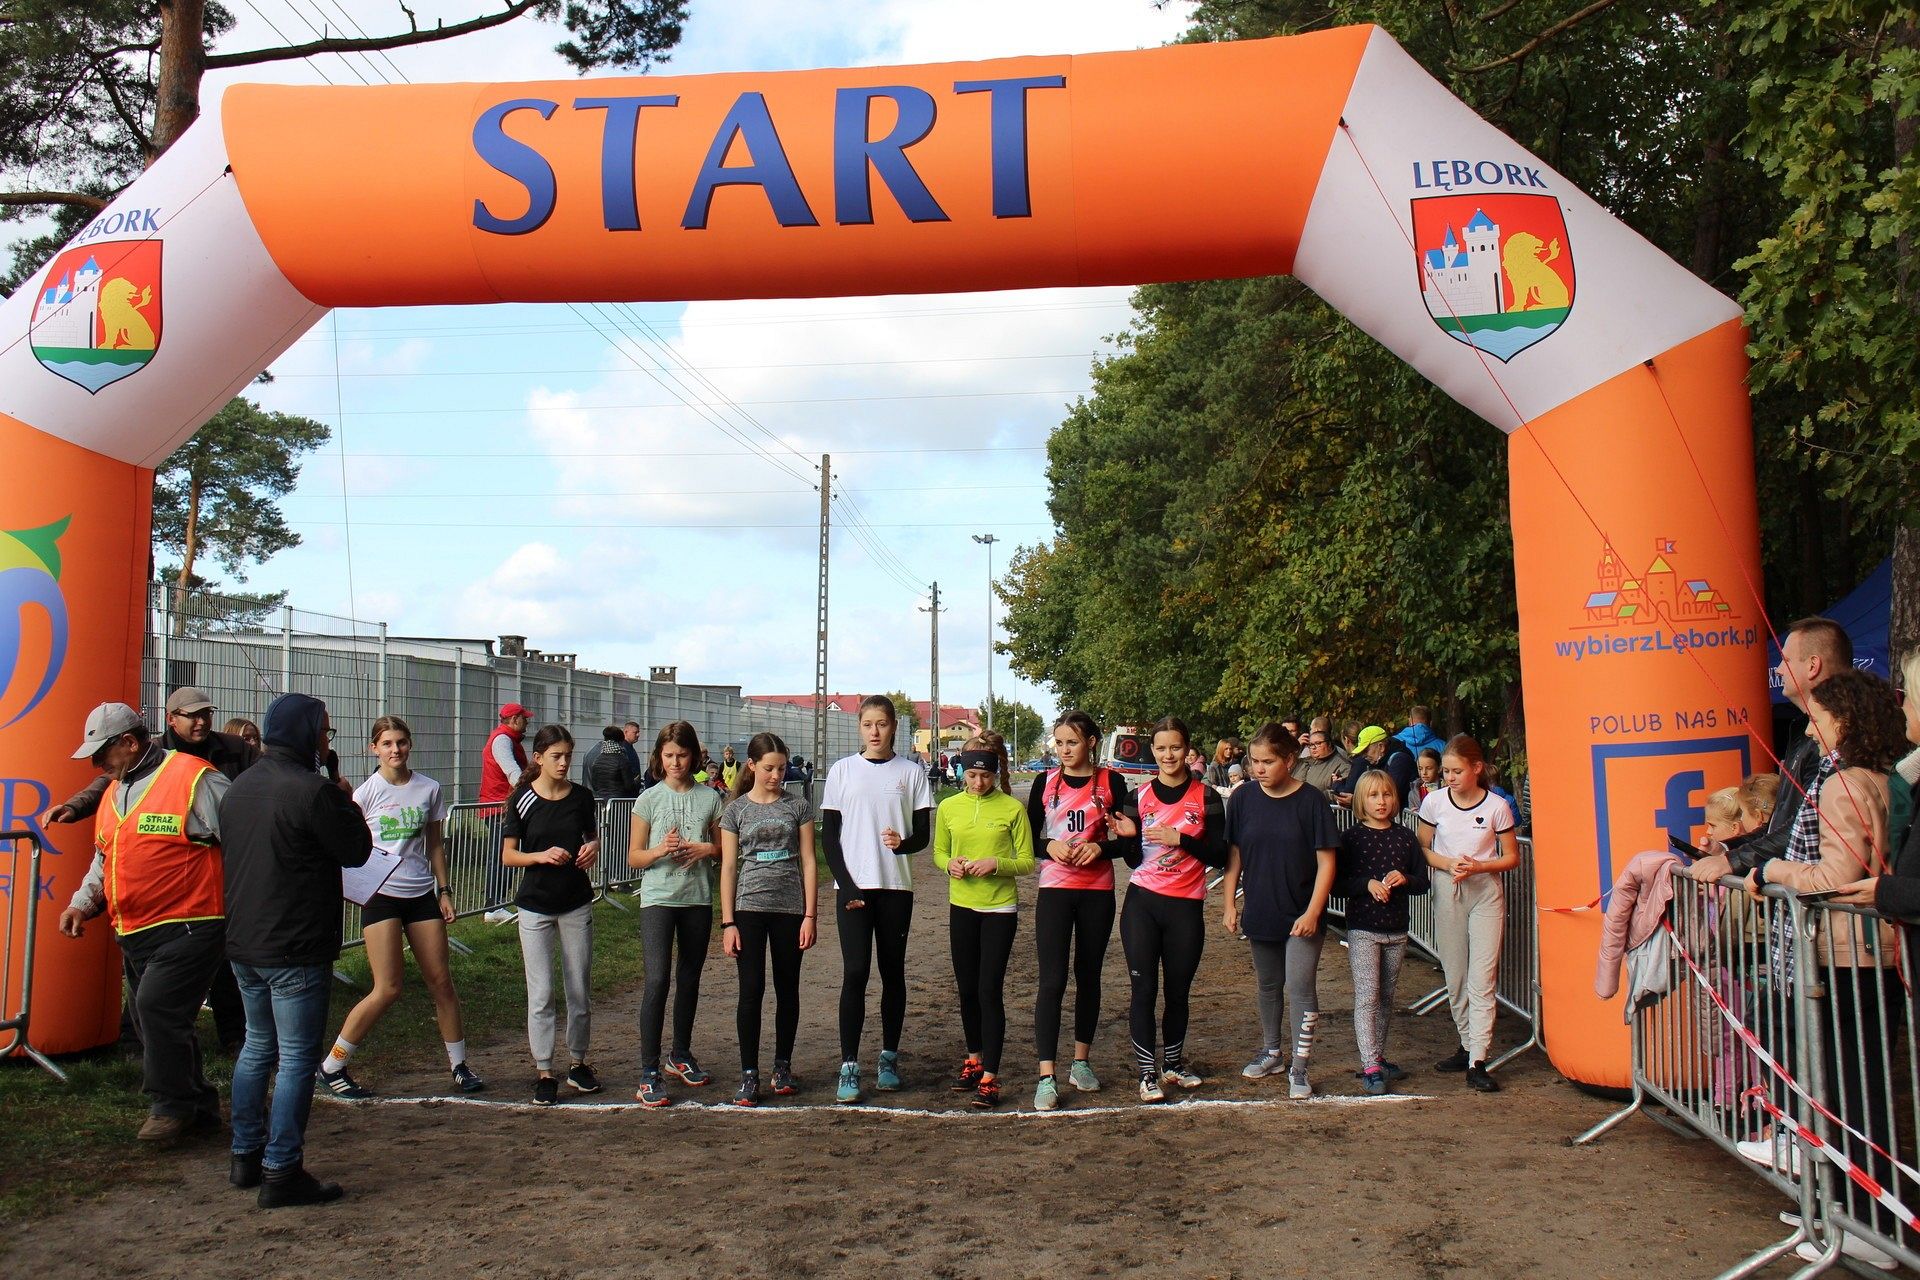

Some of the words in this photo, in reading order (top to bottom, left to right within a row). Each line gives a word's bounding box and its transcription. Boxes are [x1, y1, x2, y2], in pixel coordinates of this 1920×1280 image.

[472, 76, 1066, 236] START
[1413, 159, 1548, 191] LĘBORK
[1555, 624, 1758, 661] wybierzLębork.pl
[1590, 713, 1662, 734] POLUB
[1675, 709, 1717, 730] NAS
[1726, 706, 1749, 726] NA
[1067, 809, 1085, 833] 30
